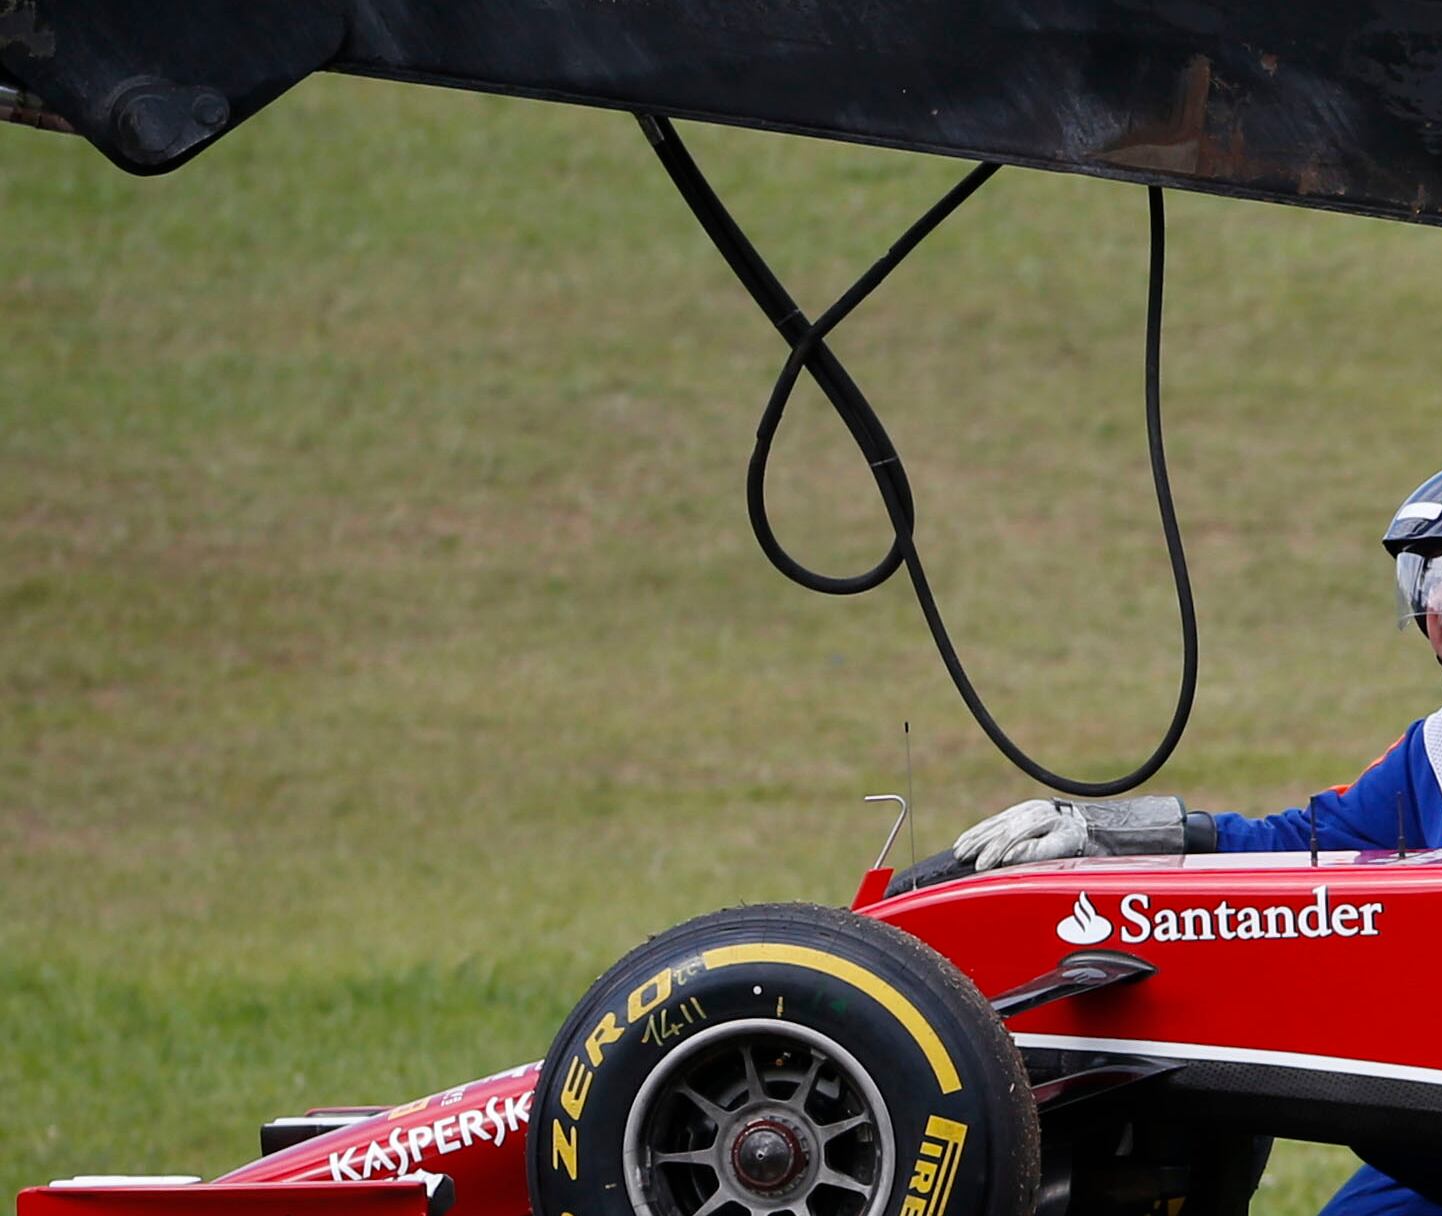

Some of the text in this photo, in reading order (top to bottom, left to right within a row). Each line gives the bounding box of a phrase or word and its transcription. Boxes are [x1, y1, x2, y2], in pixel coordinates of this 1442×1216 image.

[1120, 885, 1382, 944] Santander
[552, 966, 673, 1181] ZERO
[329, 1090, 536, 1181] KASPERSK
